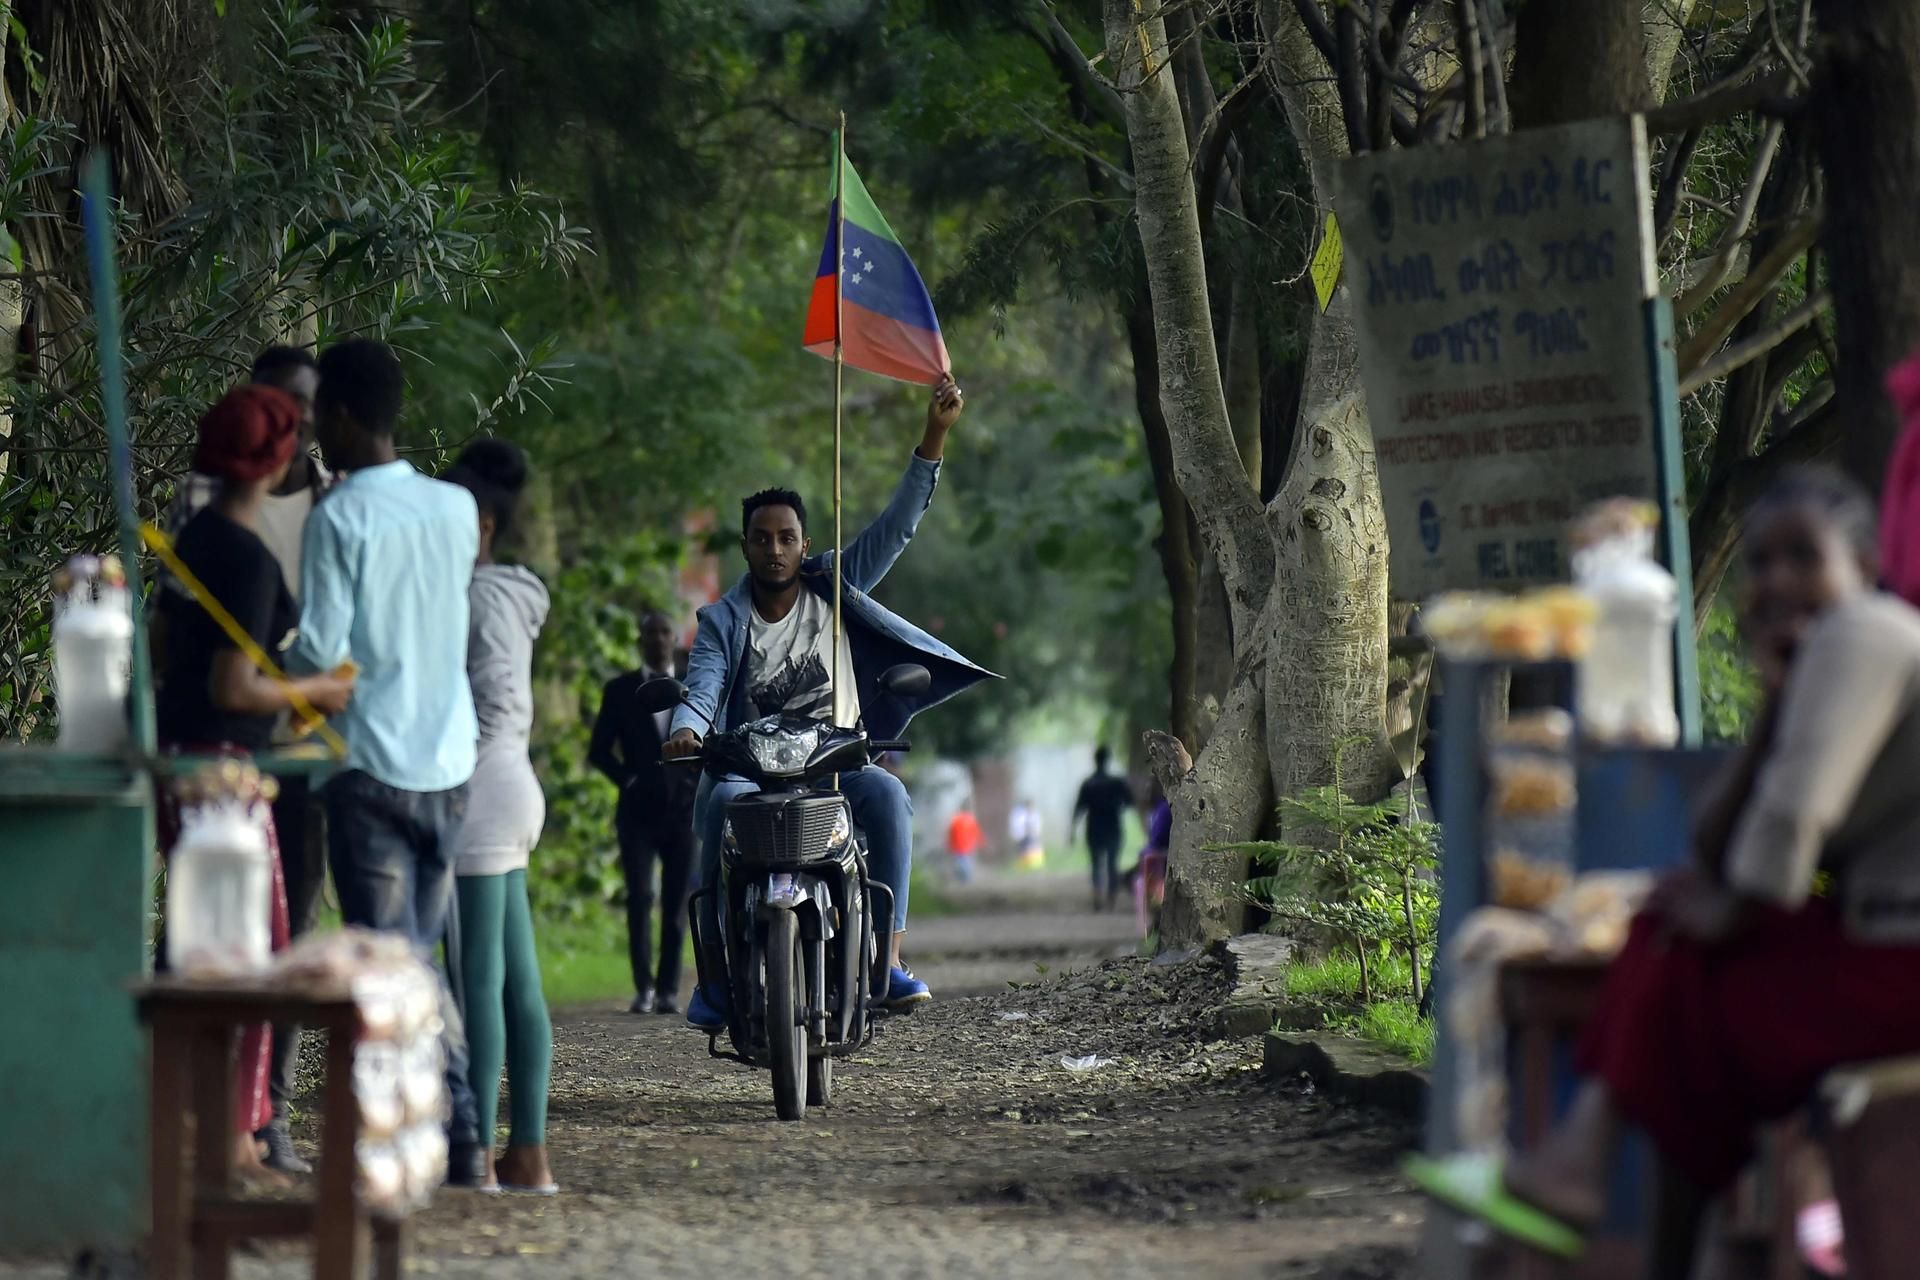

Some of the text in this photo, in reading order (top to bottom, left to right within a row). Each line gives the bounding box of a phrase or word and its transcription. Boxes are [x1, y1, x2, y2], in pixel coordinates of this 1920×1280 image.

[1400, 393, 1439, 423] LAKE
[1377, 431, 1467, 465] PROTECTION
[1472, 427, 1500, 455] AND
